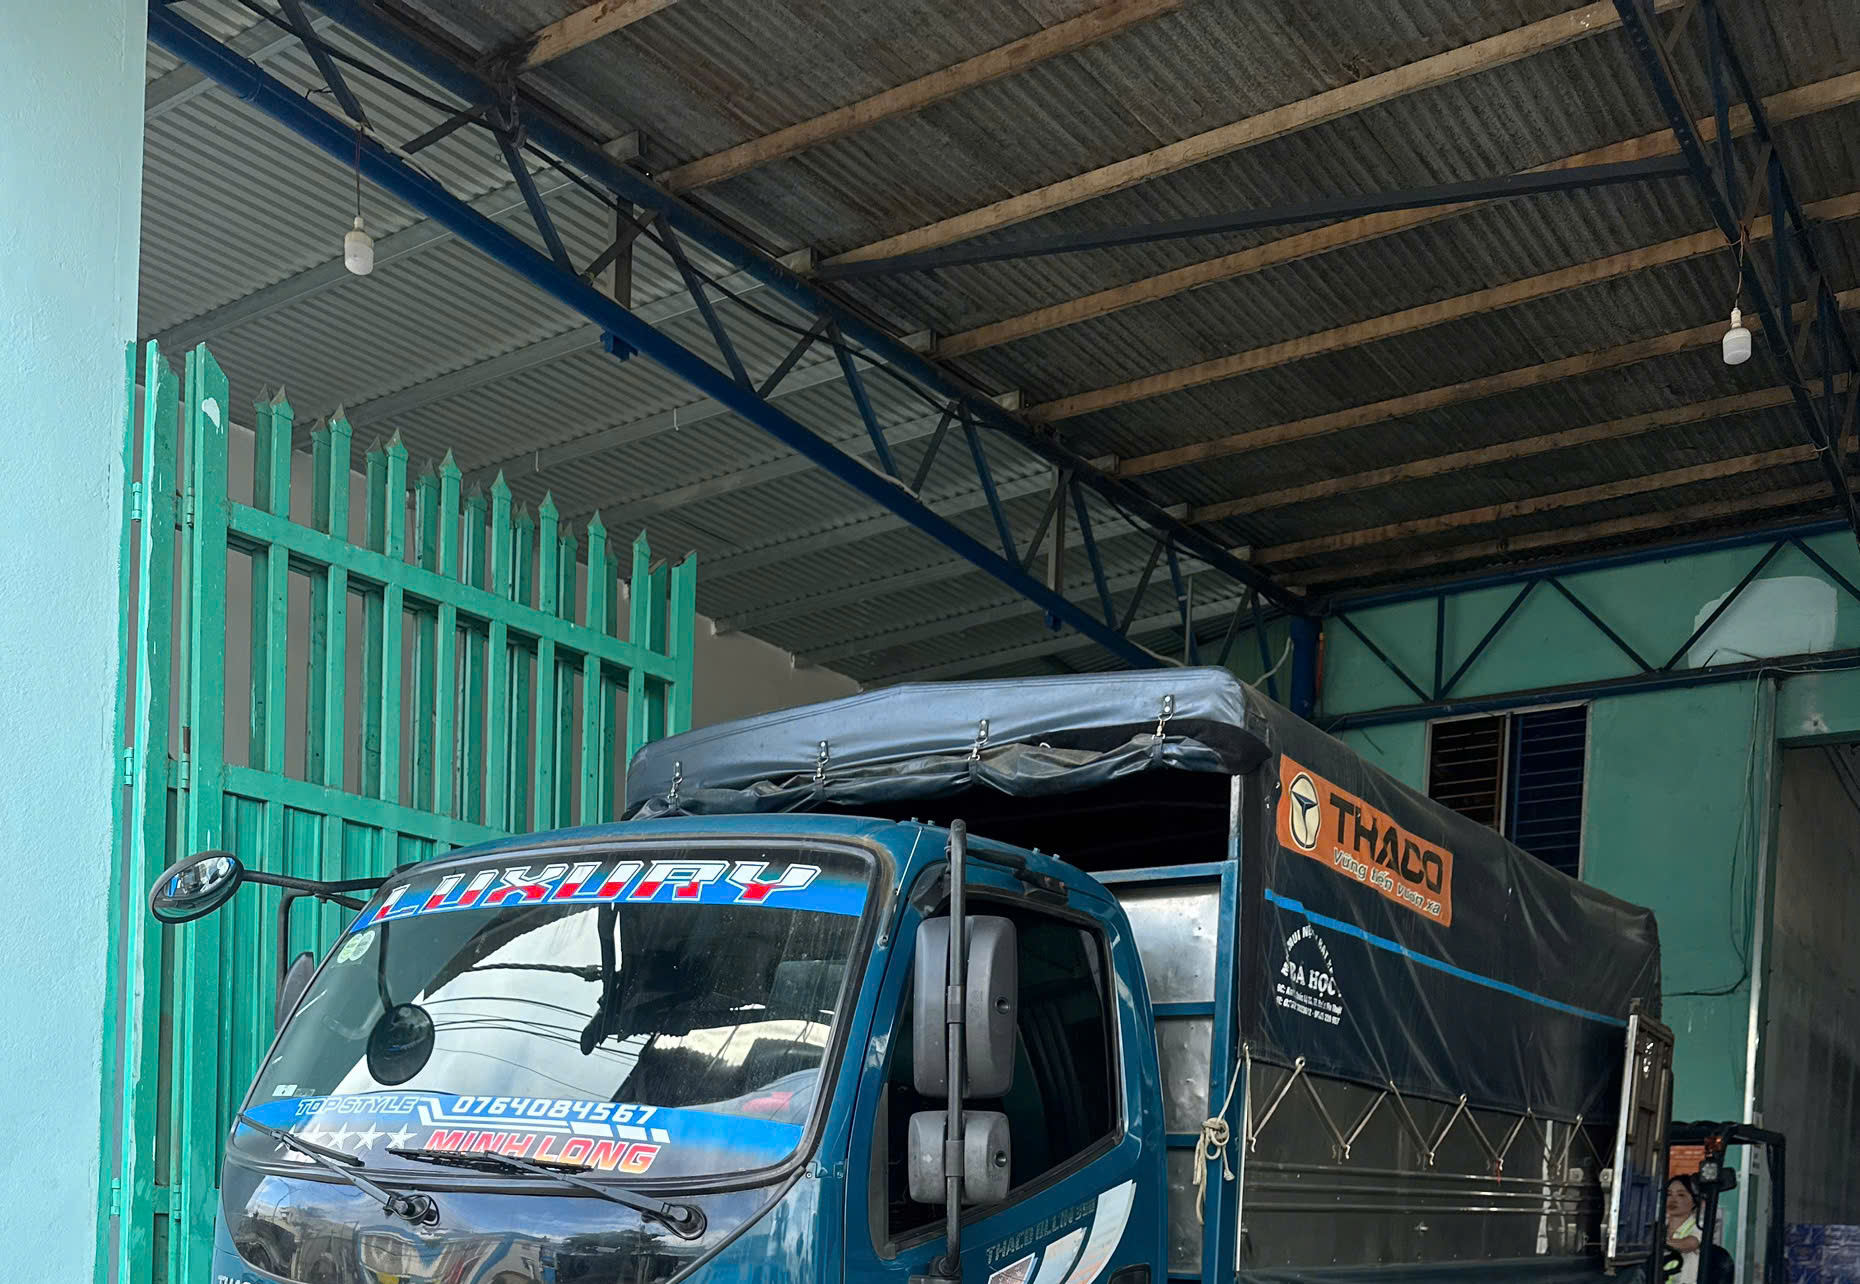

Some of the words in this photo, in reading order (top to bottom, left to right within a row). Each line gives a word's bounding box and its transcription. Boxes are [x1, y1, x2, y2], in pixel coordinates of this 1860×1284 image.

[1329, 791, 1443, 895] THACO
[369, 859, 823, 925] LUXURY
[1333, 846, 1369, 880] Vững
[1422, 898, 1442, 916] xa
[451, 1096, 657, 1125] 0764084567
[423, 1129, 536, 1158] MINH
[533, 1133, 661, 1174] LONG
